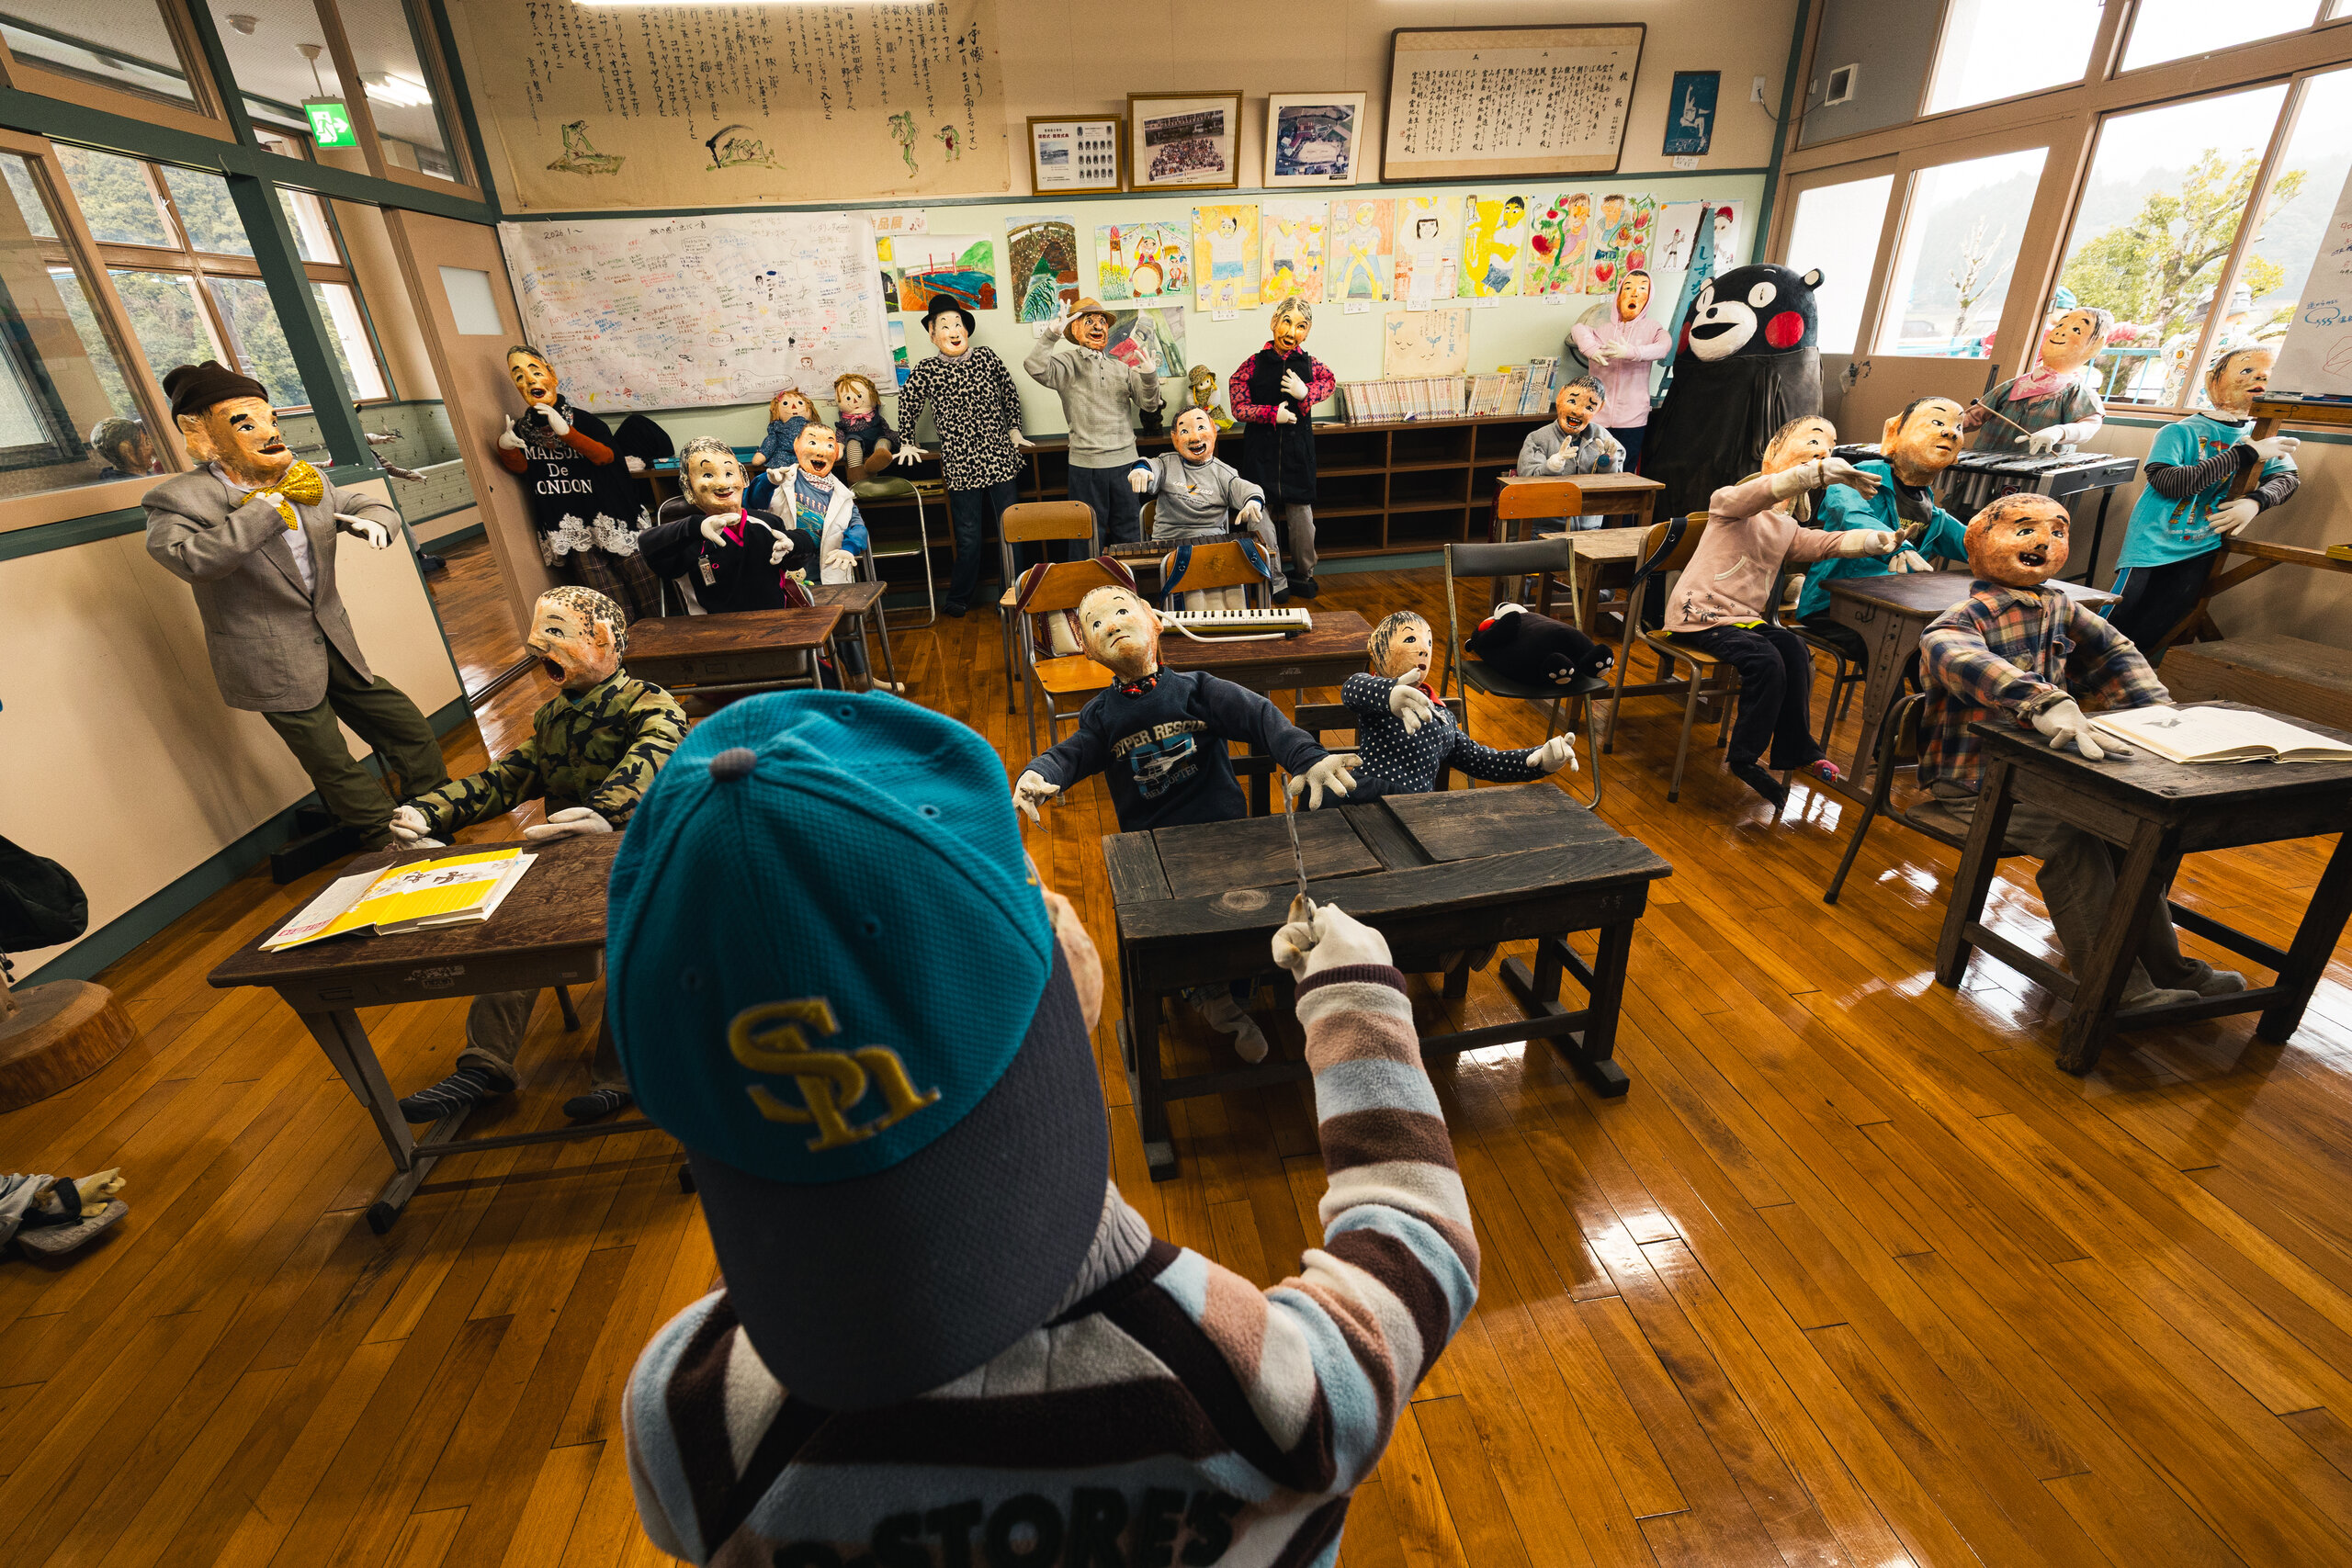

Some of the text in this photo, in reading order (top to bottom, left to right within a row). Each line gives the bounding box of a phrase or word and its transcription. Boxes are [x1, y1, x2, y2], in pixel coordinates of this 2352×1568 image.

[547, 463, 569, 477] De
[536, 479, 593, 495] ONDON
[1144, 764, 1198, 799] HELICOPTER
